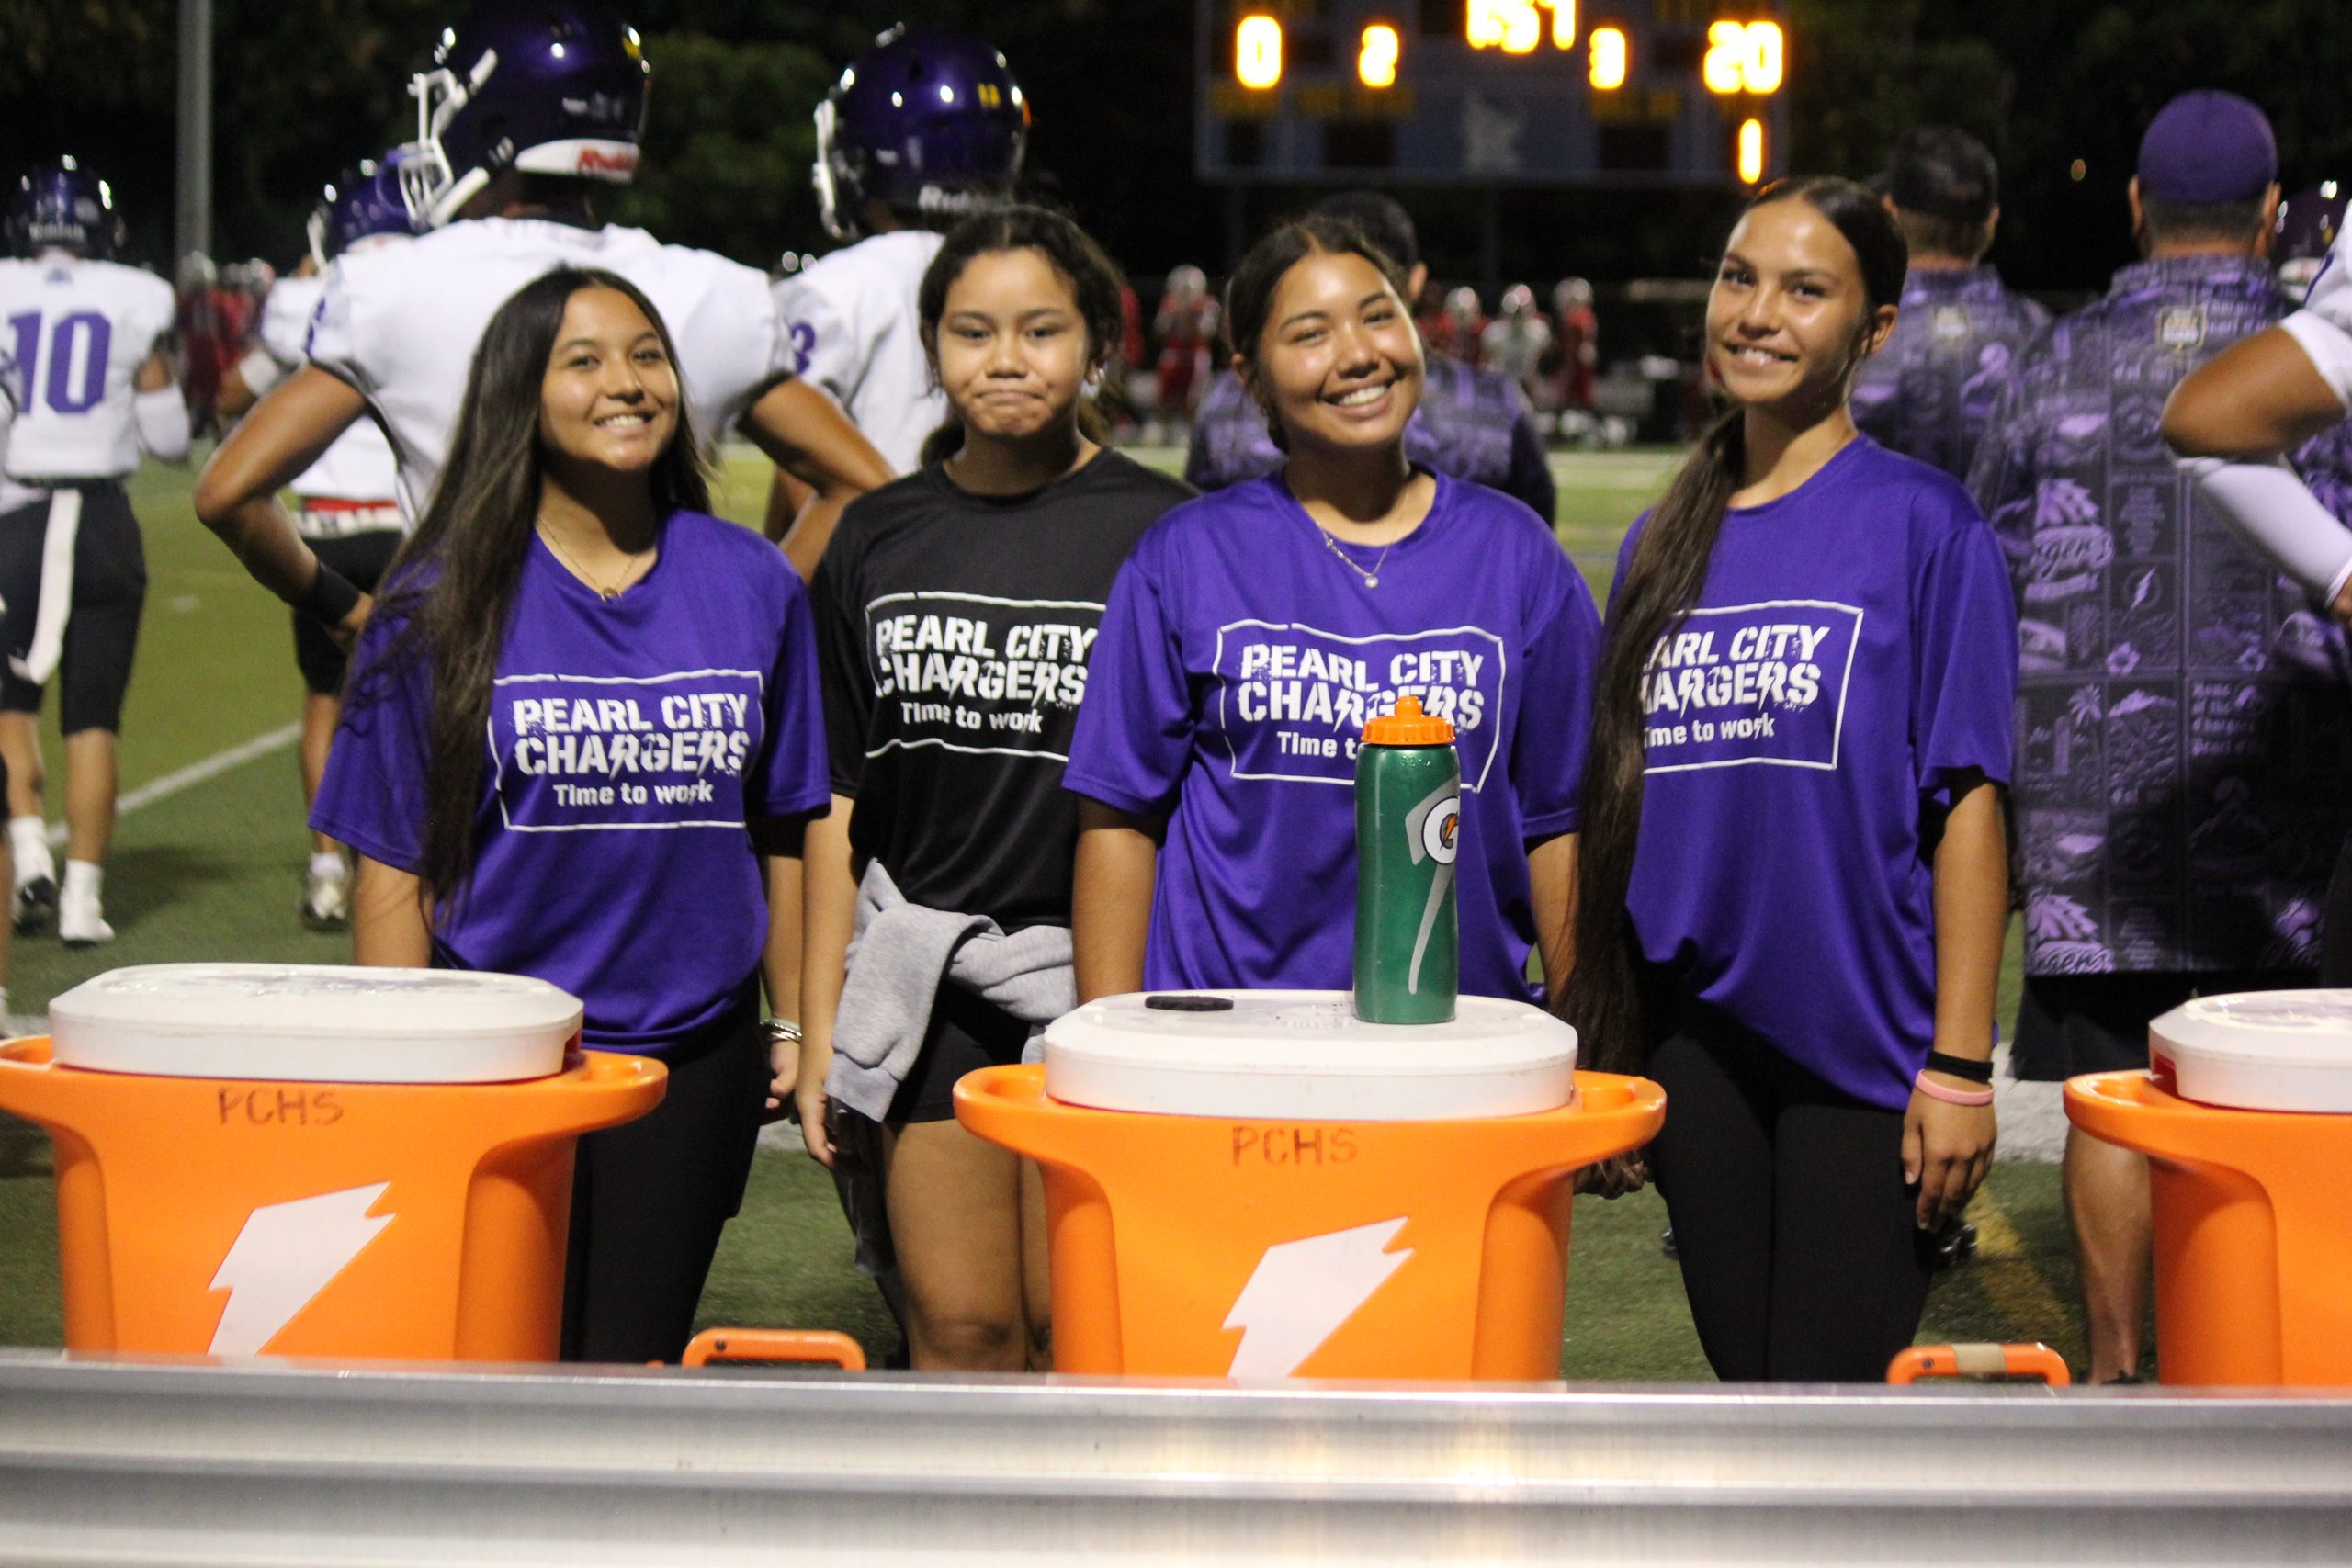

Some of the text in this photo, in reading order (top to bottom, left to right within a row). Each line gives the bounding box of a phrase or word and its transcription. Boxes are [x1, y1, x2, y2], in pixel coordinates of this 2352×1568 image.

[1236, 16, 1283, 89] 0
[1358, 25, 1398, 88] 2
[1589, 28, 1625, 89] 3
[1703, 20, 1782, 94] 20
[1739, 119, 1762, 184] 1
[8, 309, 111, 415] 10
[876, 615, 1099, 663] PEARL CITY
[1643, 624, 1831, 671] ARL CITY
[875, 653, 1089, 707] CHARGERS
[1240, 644, 1484, 692] PEARL CITY
[1640, 661, 1822, 718] ARGERS
[512, 693, 749, 735] PEARL CITY
[900, 702, 1043, 733] Time to work
[1644, 713, 1775, 749] ime to work
[514, 730, 751, 779] CHARGERS
[1277, 731, 1338, 758] Time
[553, 779, 714, 807] Time to work
[219, 1088, 345, 1127] PCHS
[1233, 1126, 1358, 1167] PCHS
